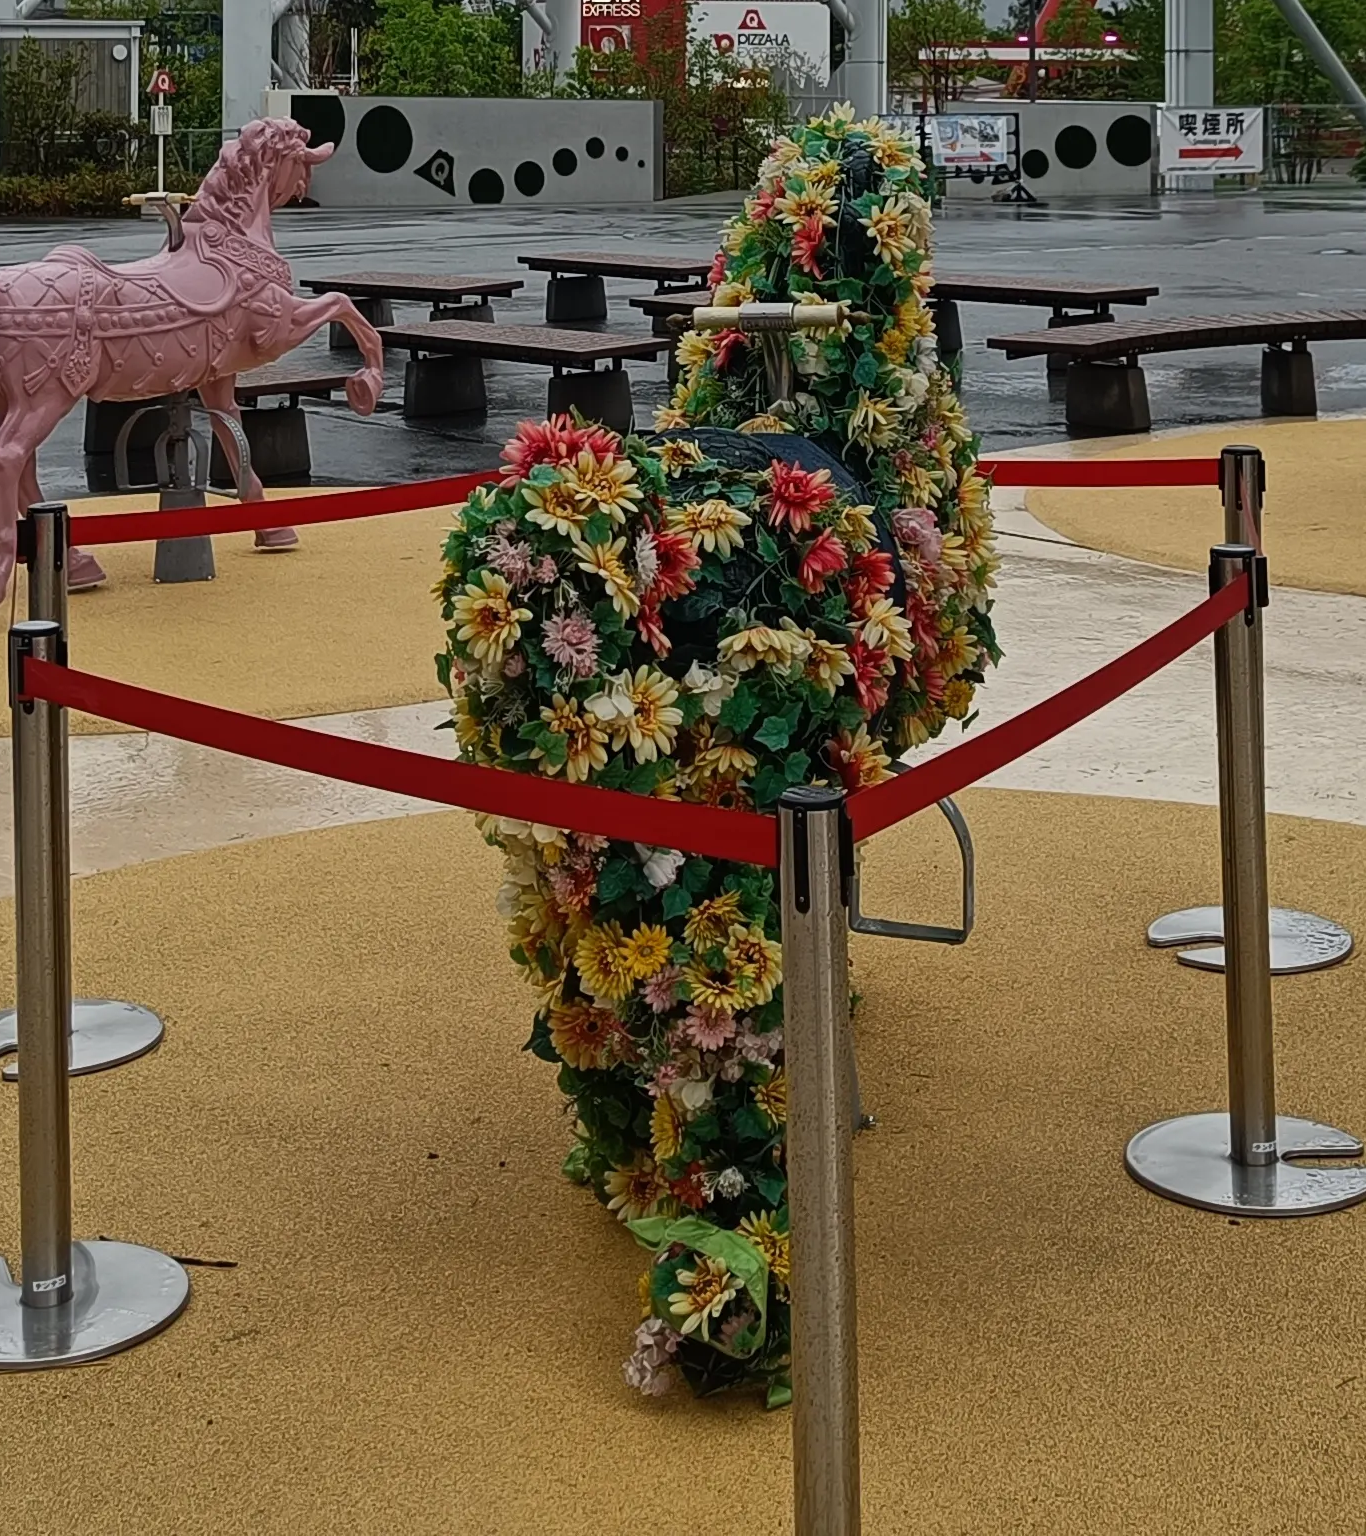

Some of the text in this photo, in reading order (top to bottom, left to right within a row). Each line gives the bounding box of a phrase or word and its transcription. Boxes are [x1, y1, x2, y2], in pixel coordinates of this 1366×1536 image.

[582, 4, 640, 17] EXPRESS
[745, 12, 759, 28] Q
[737, 33, 791, 46] PIZZA-LA
[158, 74, 170, 91] Q
[1178, 111, 1245, 137] 喫煙所
[430, 157, 450, 186] Q
